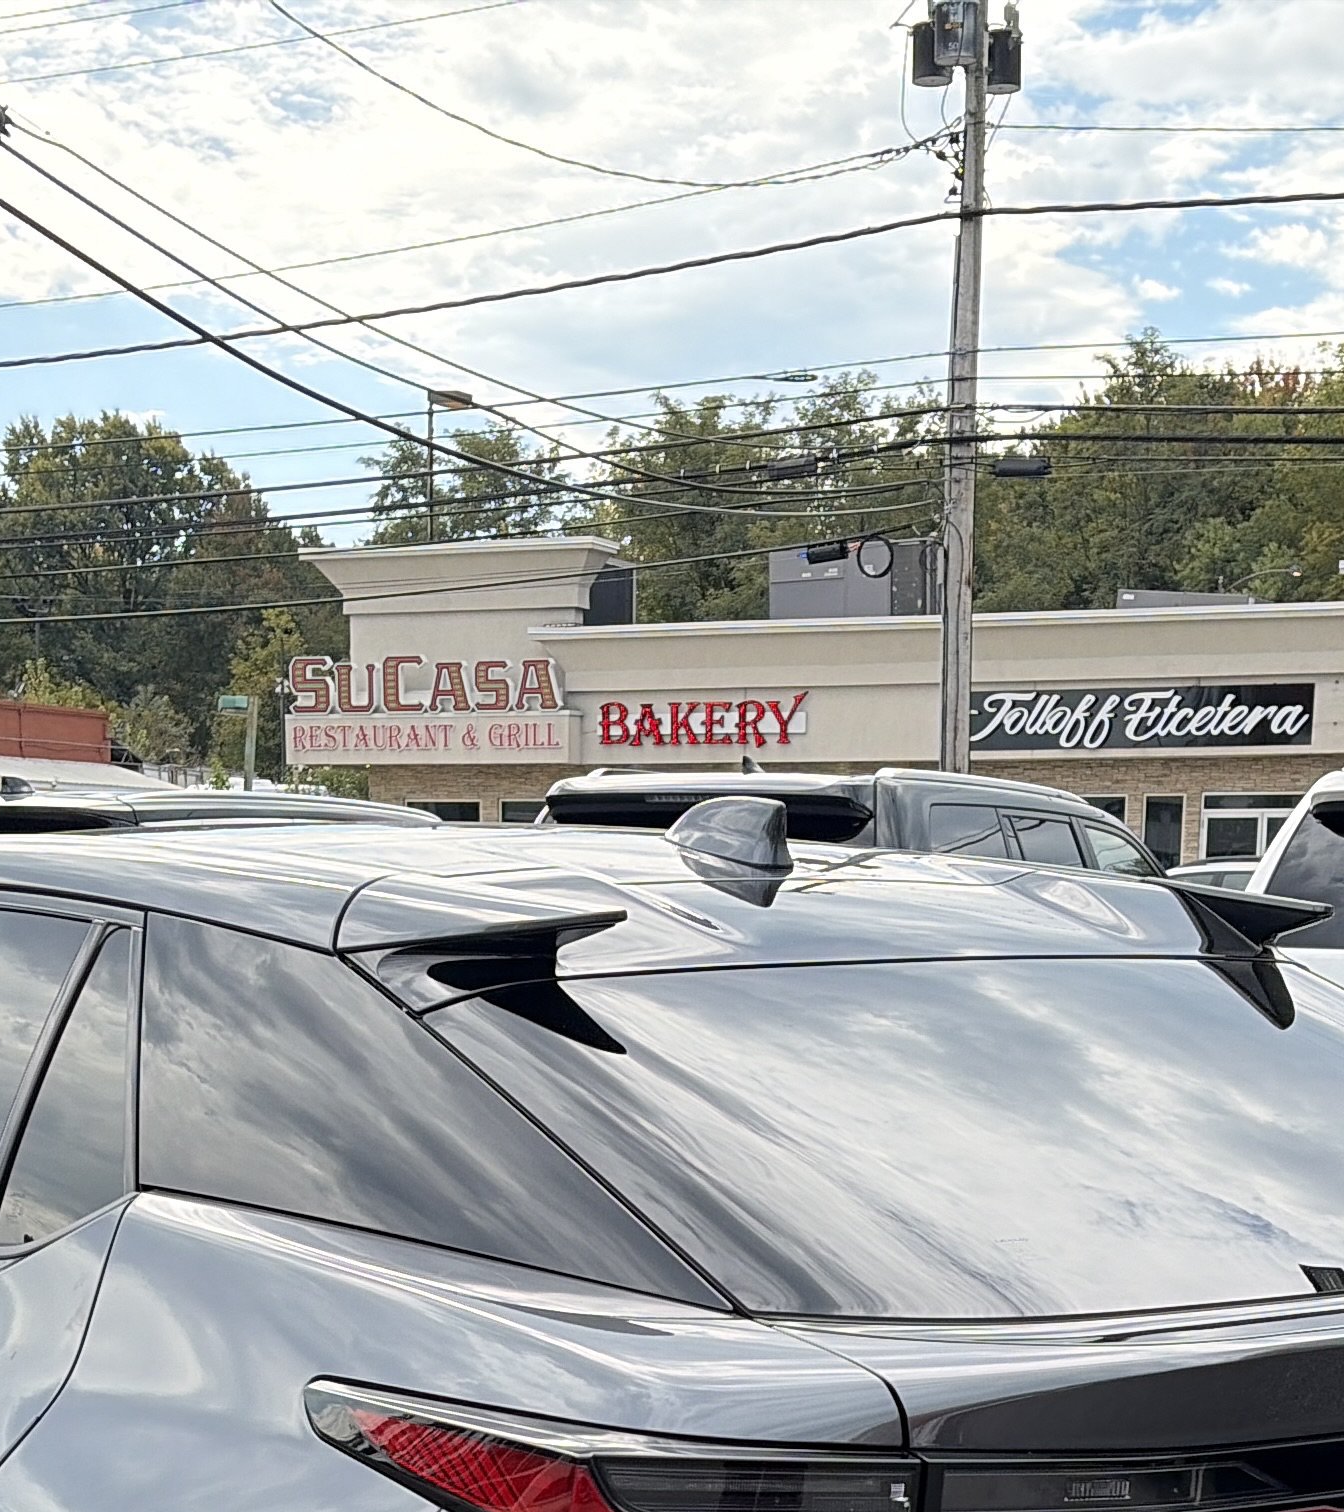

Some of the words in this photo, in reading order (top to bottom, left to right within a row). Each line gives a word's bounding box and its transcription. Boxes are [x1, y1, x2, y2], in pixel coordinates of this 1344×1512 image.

[292, 724, 455, 750] RESTAURANT
[461, 722, 478, 748] &
[488, 721, 560, 748] GRILL
[599, 690, 809, 748] BAKERY
[1123, 689, 1309, 741] Etcetera
